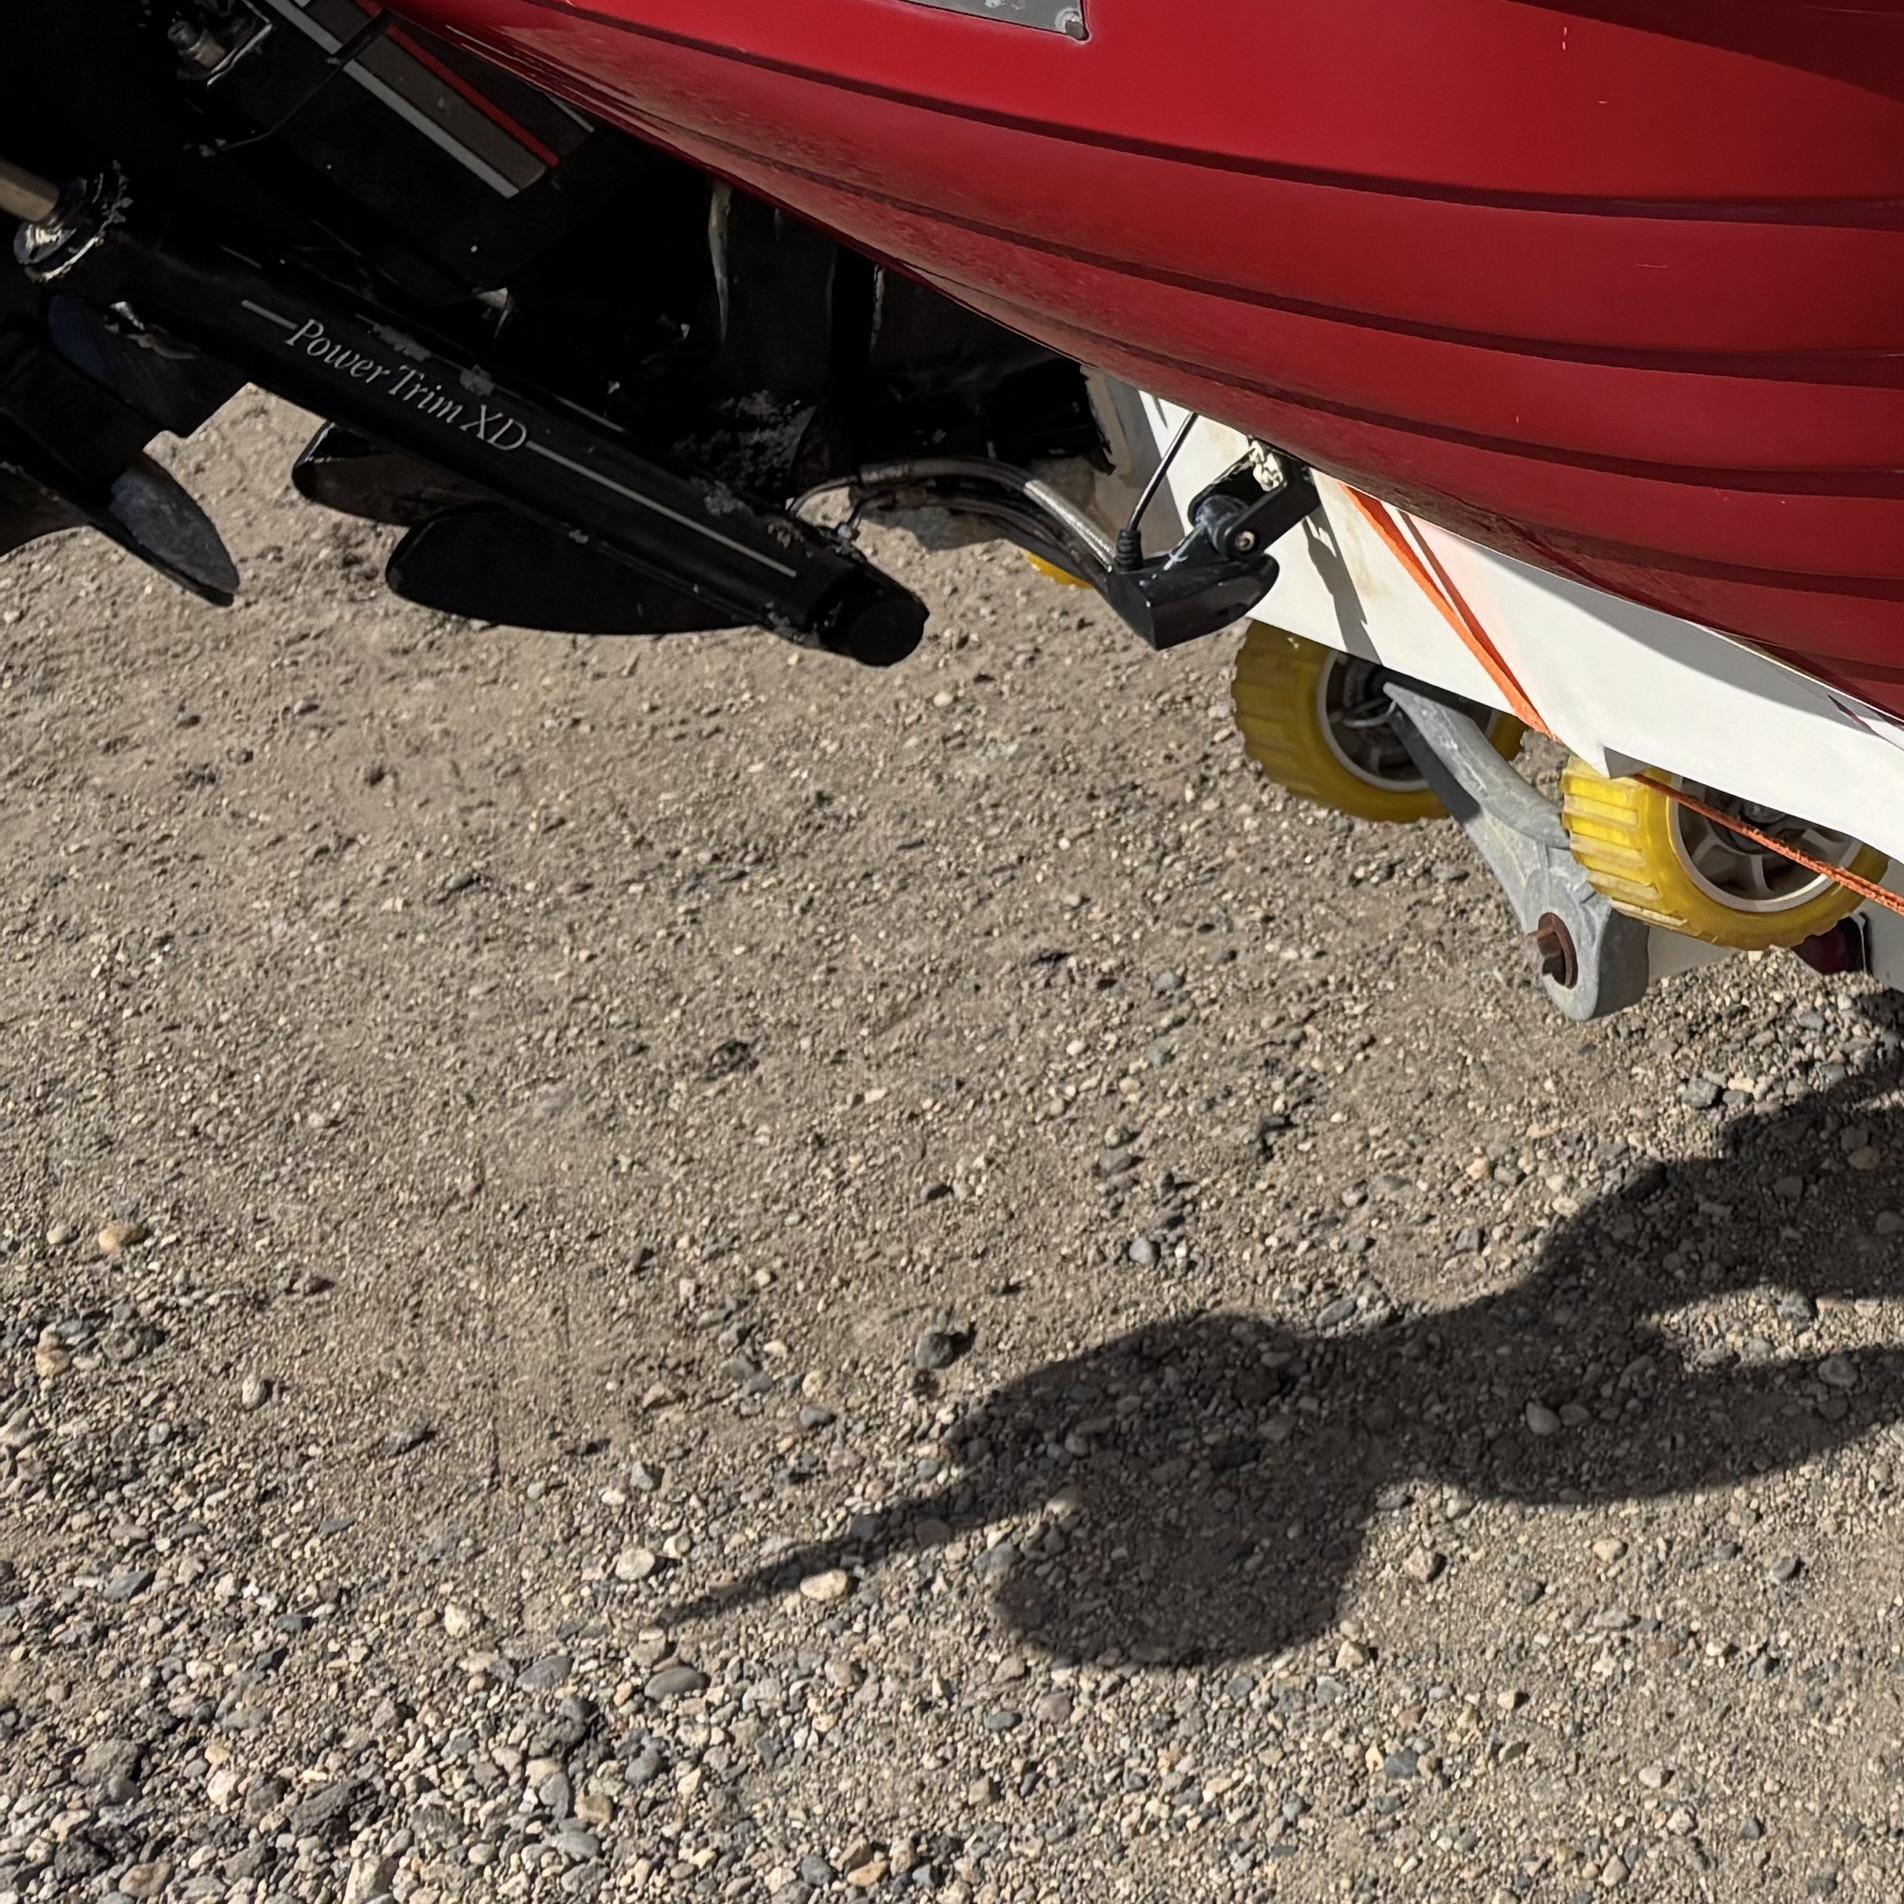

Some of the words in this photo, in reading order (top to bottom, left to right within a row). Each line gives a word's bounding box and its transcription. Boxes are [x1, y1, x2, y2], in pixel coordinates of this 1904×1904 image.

[285, 318, 391, 384] Power
[388, 364, 464, 424] Trim
[459, 404, 527, 451] XD
